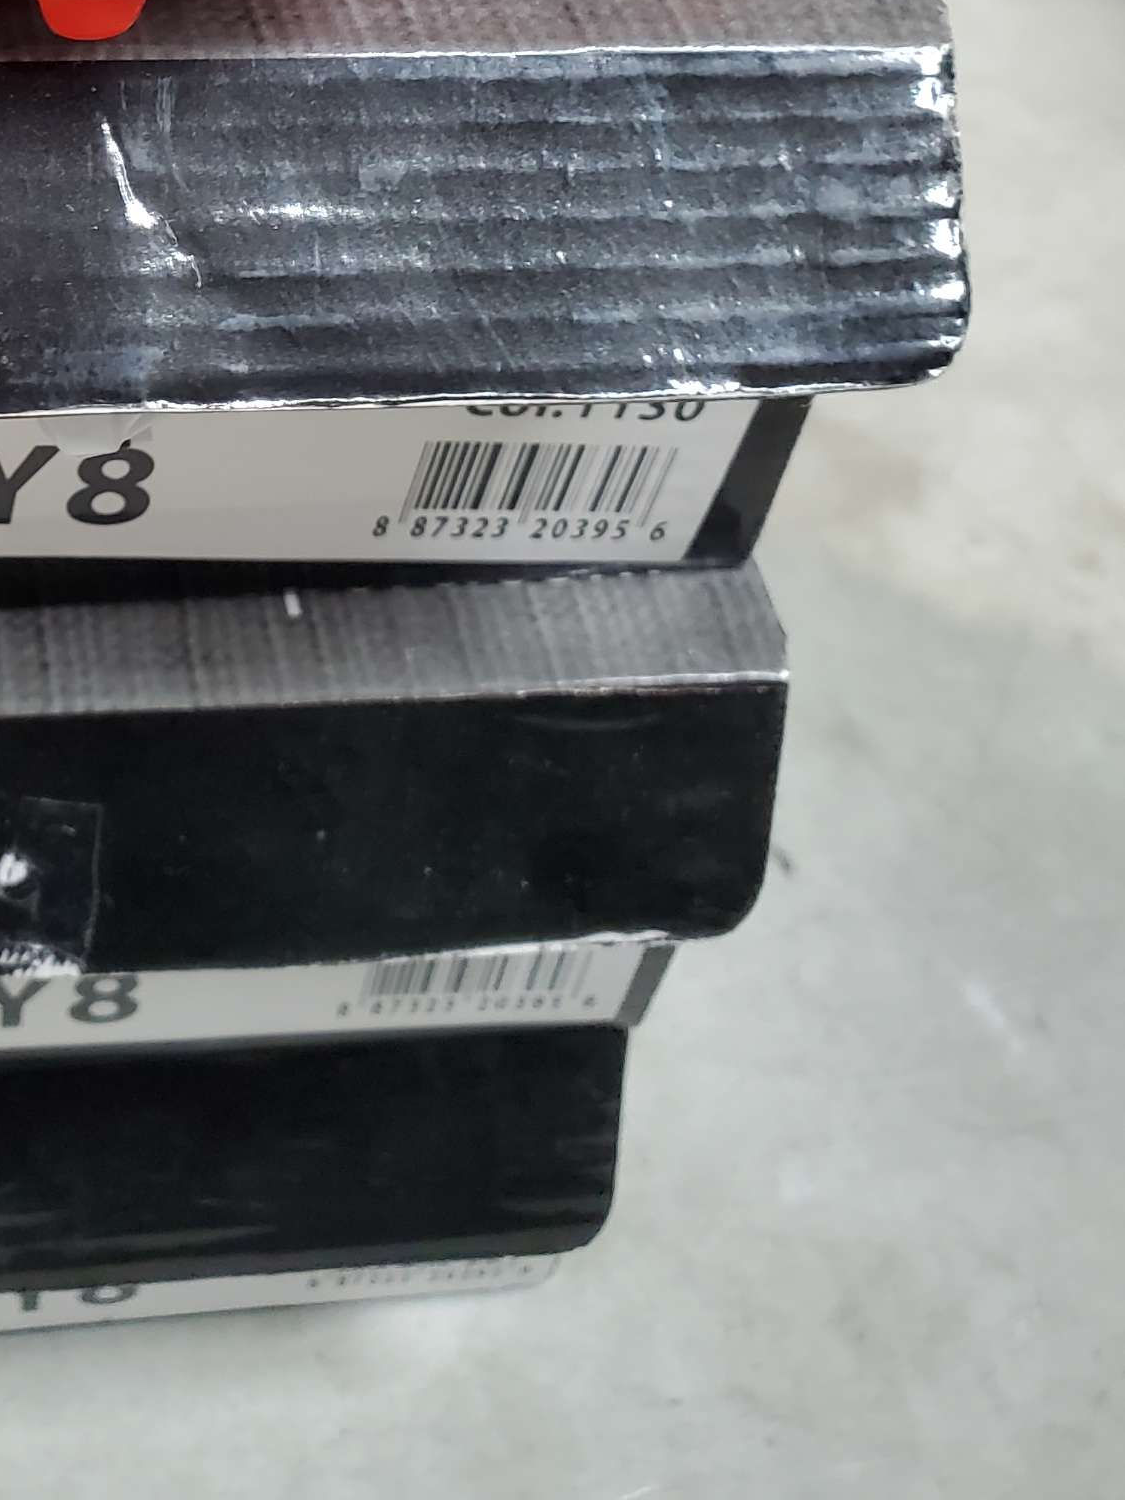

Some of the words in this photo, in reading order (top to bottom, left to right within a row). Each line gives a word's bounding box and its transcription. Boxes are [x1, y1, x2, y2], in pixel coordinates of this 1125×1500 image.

[372, 515, 390, 537] 8
[410, 516, 509, 539] 87323
[529, 518, 630, 540] 20395
[649, 521, 667, 541] 6
